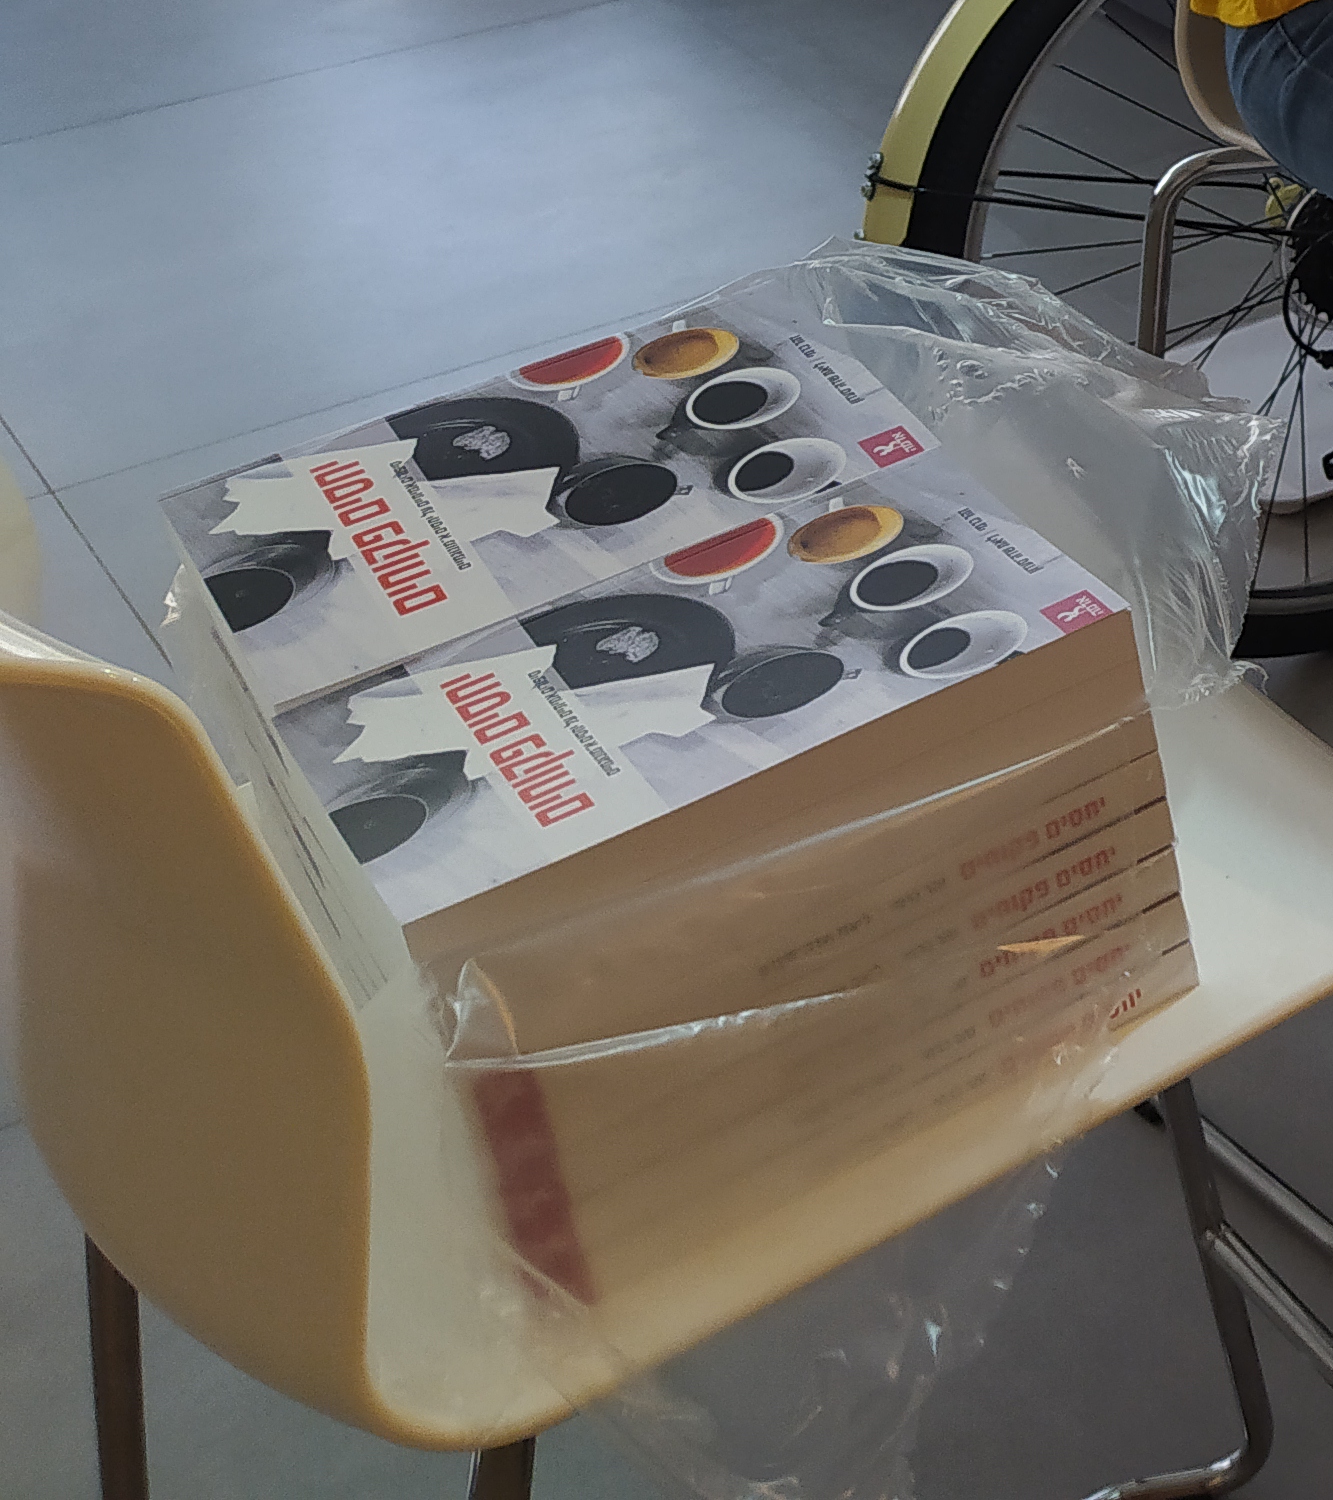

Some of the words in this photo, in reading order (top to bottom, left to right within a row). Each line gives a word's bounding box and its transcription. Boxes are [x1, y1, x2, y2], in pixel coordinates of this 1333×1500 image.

[309, 460, 391, 527] יחסים
[350, 523, 447, 617] פקוחים
[426, 514, 447, 534] יחסים
[440, 674, 531, 745] יחסים
[488, 733, 594, 827] פקוחים
[1044, 796, 1106, 839] יחסים
[1053, 845, 1115, 888] יחסים
